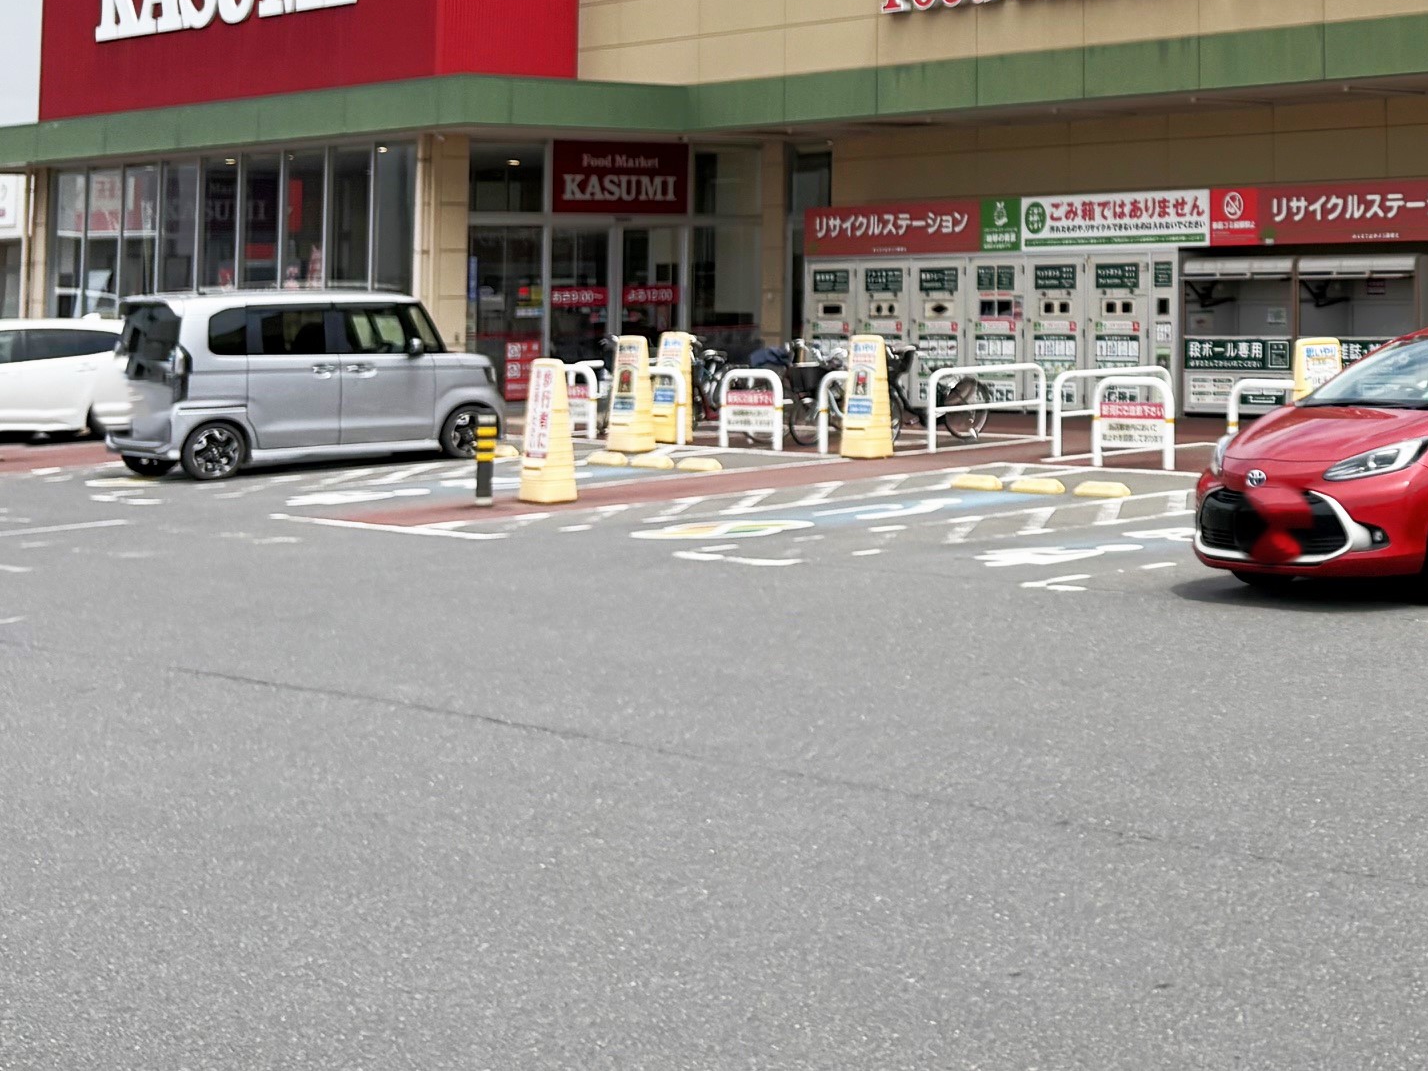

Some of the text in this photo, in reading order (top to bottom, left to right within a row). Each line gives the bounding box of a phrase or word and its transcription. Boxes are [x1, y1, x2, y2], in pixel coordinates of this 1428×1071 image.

[582, 153, 659, 169] Food Market
[562, 173, 678, 201] KASUMI
[1050, 195, 1205, 222] ごみ箱ではありません
[815, 212, 968, 238] リサイクルステーション
[1188, 341, 1263, 358] 段ボール専用
